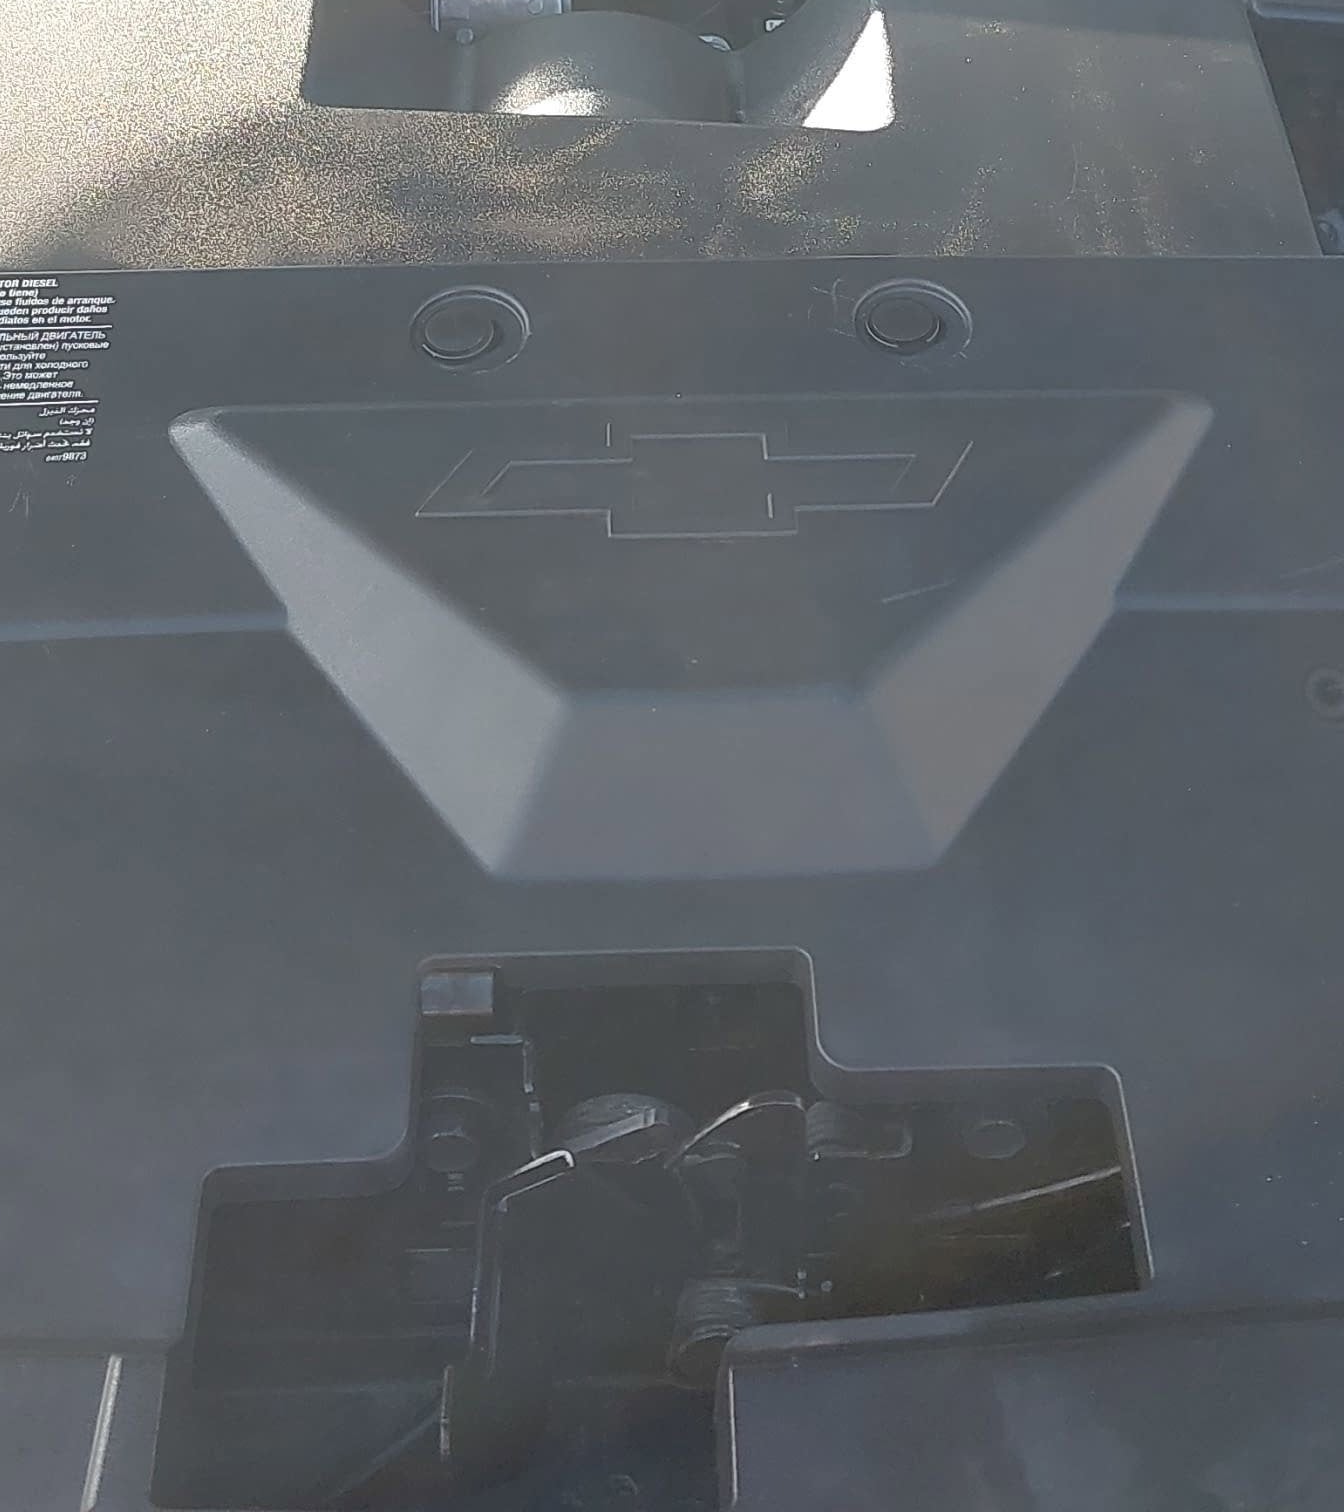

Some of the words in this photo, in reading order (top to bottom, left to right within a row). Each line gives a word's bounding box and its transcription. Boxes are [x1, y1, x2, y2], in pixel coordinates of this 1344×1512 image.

[21, 279, 59, 288] DIESEL
[8, 288, 39, 297] tiene)
[14, 297, 49, 306] fluidos
[51, 296, 65, 305] de
[67, 296, 116, 305] arranque.
[31, 306, 75, 316] producir
[77, 305, 108, 314] daños
[31, 316, 45, 324] en
[47, 315, 58, 324] el
[40, 331, 106, 342] ДВИГАТЕЛЬ
